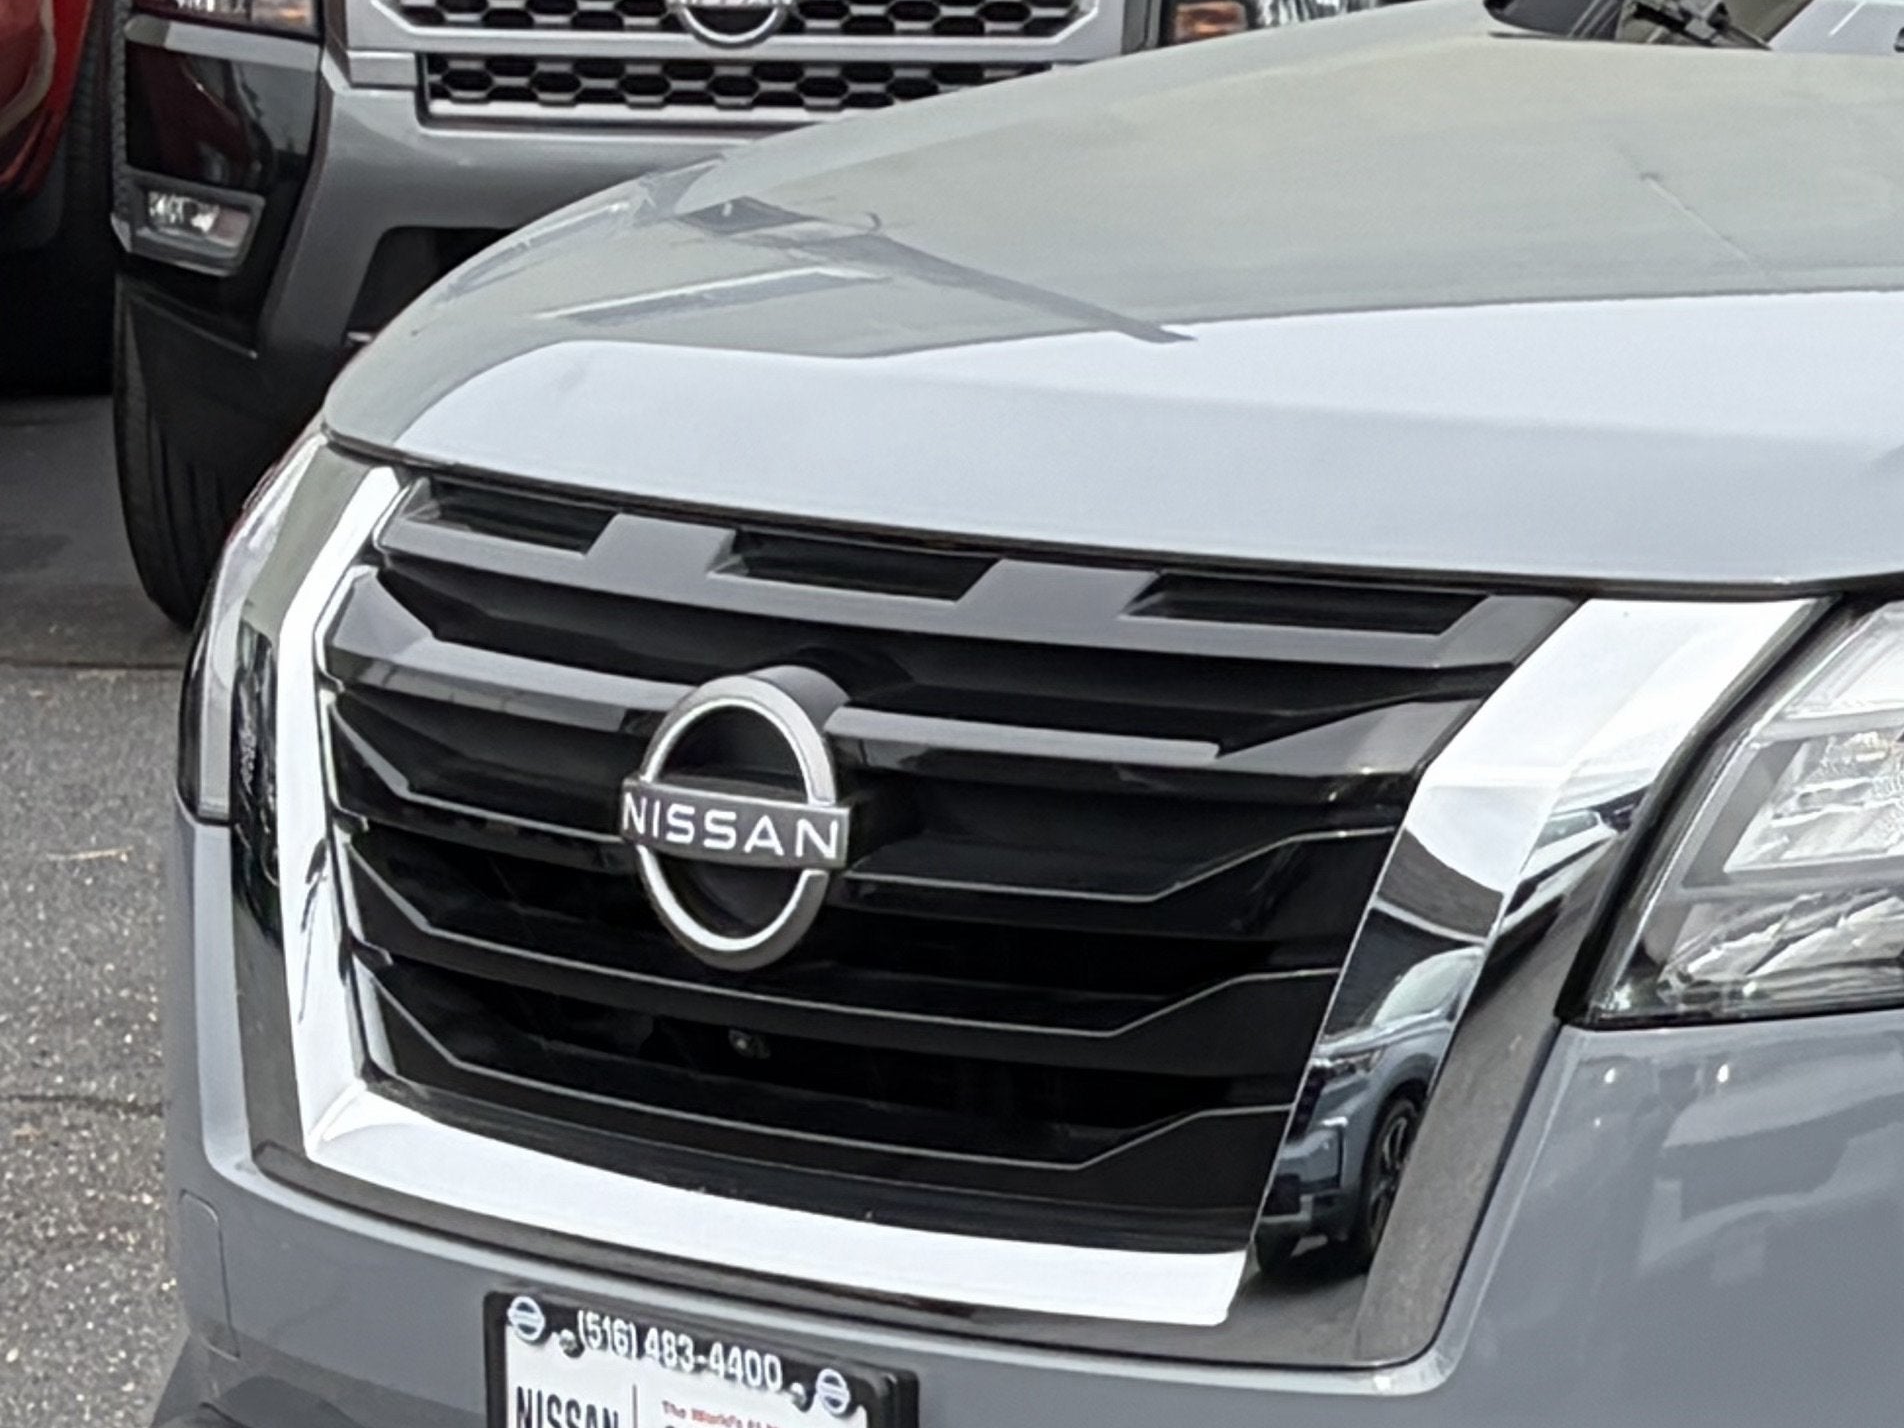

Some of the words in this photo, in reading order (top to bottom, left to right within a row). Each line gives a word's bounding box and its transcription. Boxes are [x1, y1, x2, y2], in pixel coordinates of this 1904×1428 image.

[623, 791, 839, 860] NISSAN
[577, 1310, 637, 1359] (516)
[645, 1327, 783, 1391] 483-4400
